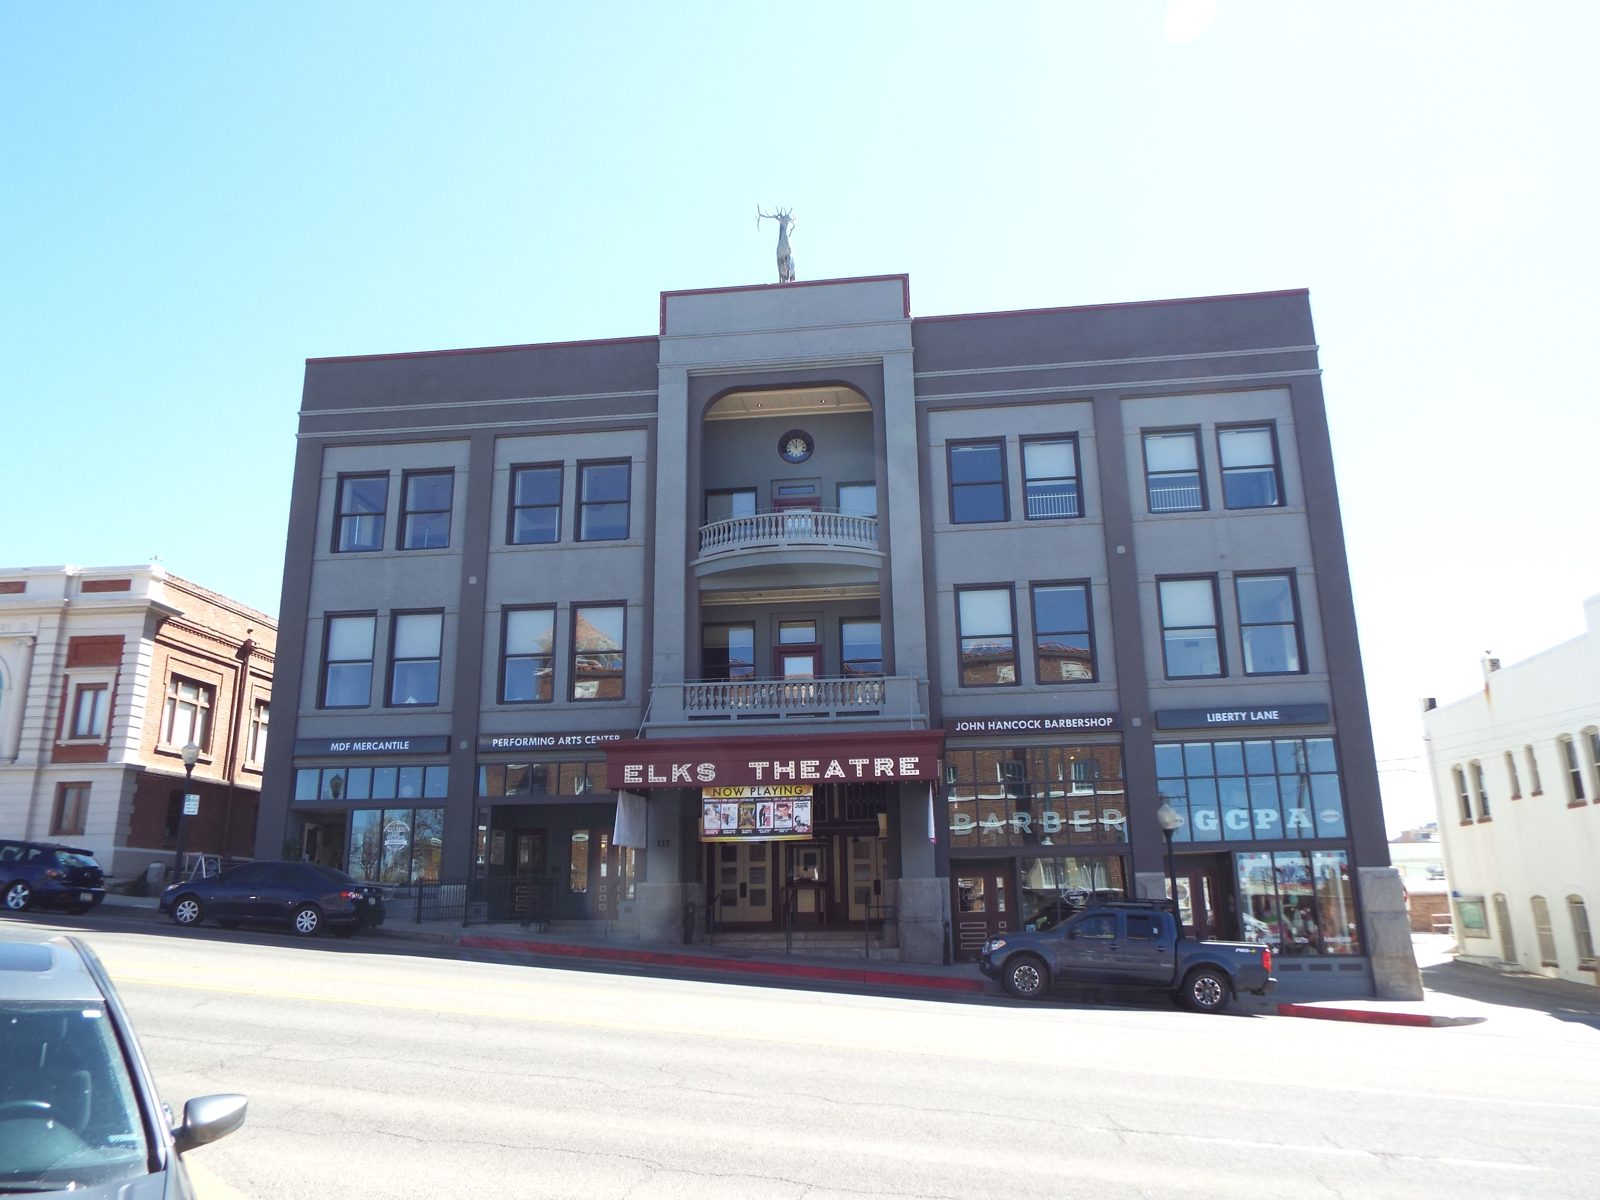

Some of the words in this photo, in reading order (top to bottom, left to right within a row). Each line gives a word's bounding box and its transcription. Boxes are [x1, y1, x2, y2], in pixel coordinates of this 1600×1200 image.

[1206, 711, 1247, 722] LIBERTY
[1250, 710, 1280, 720] LANE
[955, 722, 985, 731] JOHN
[987, 720, 1042, 730] HANCOCK
[1044, 717, 1113, 729] BARBERSHOP
[330, 742, 351, 751] MDF
[352, 741, 410, 751] MERCANTILE
[492, 737, 555, 747] PERFORMING
[558, 736, 582, 745] ARTS
[623, 762, 717, 783] ELKS
[748, 757, 920, 780] THEATRE
[712, 787, 745, 797] NOW
[750, 786, 804, 796] PLAYING
[953, 808, 1124, 836] BARBER
[1194, 808, 1313, 831] GCPA
